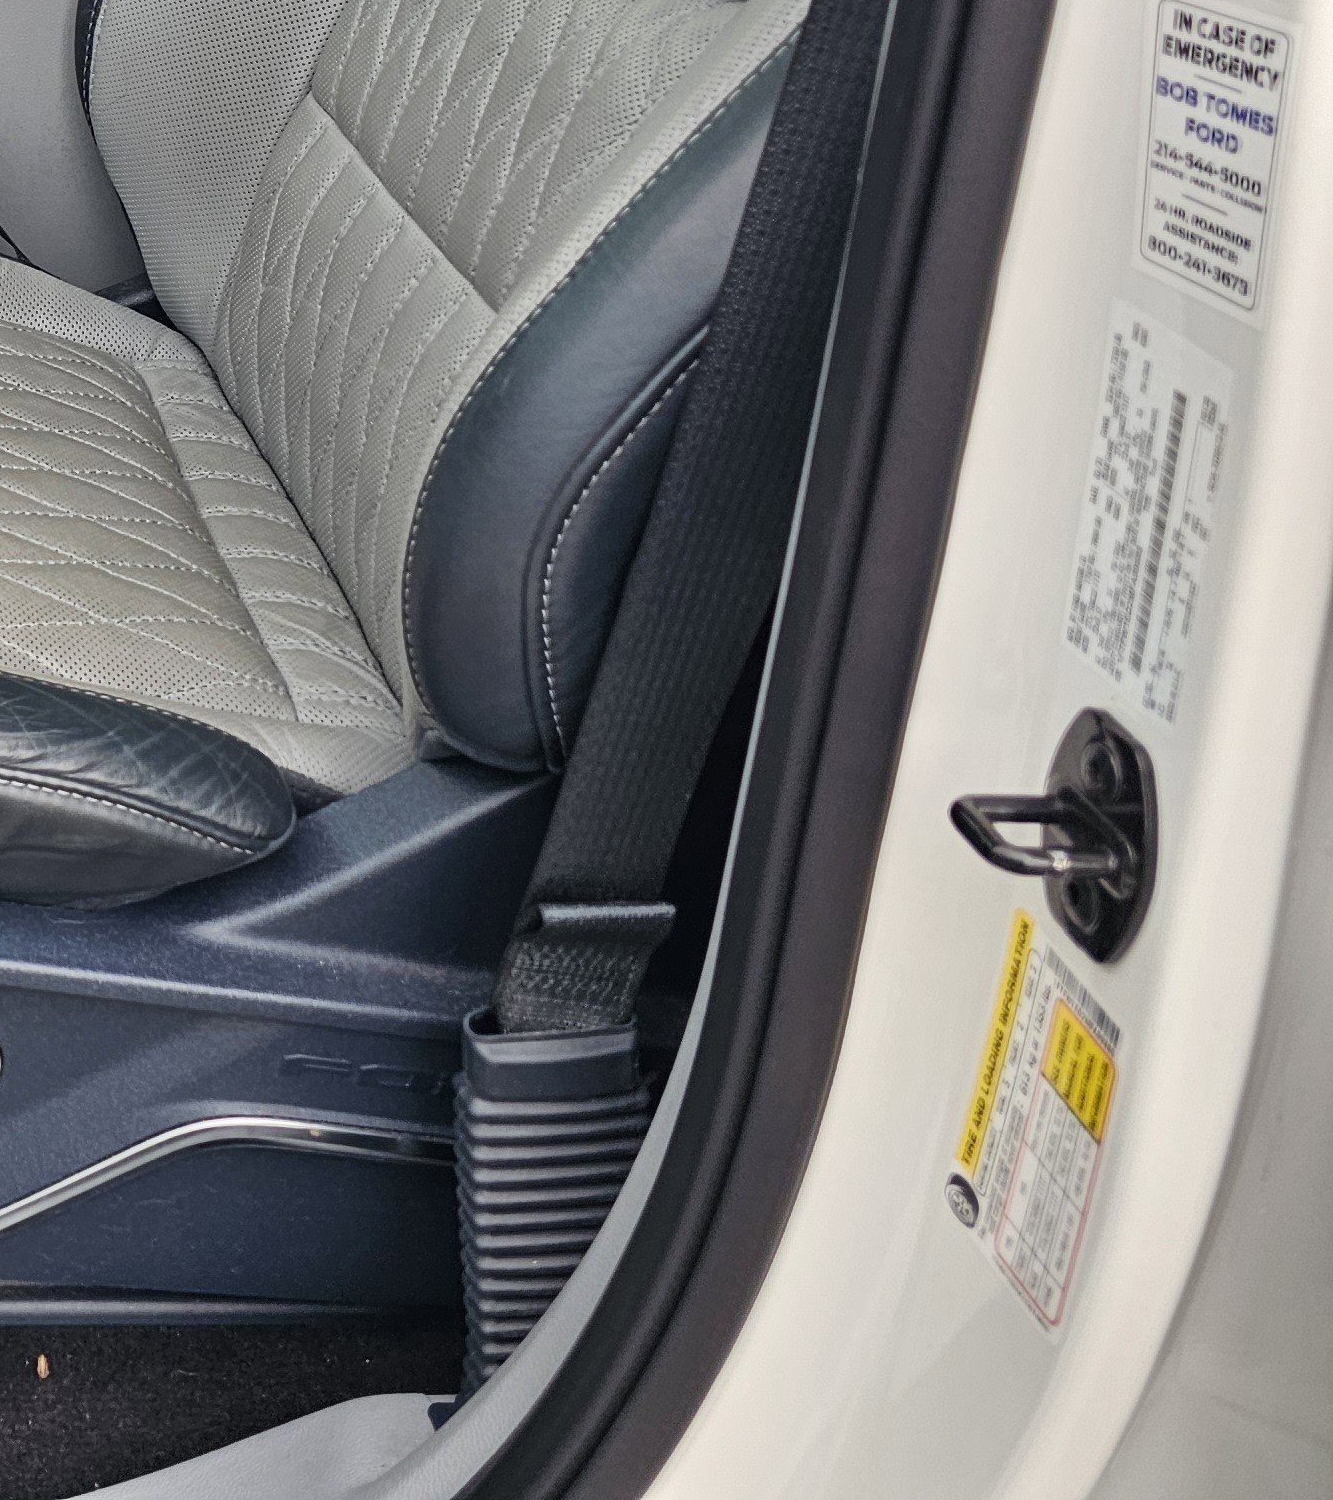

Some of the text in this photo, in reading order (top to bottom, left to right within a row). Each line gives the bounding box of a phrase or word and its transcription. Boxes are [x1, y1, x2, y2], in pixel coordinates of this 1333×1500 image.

[1172, 9, 1276, 57] IN CASE OF
[1162, 34, 1280, 93] EMERGENCY
[1156, 75, 1275, 137] BOB TOMES
[1184, 118, 1239, 154] FORD
[1192, 213, 1251, 251] ROADSIDE
[961, 918, 1029, 1165] TIRE AND LOADING INFORMATION
